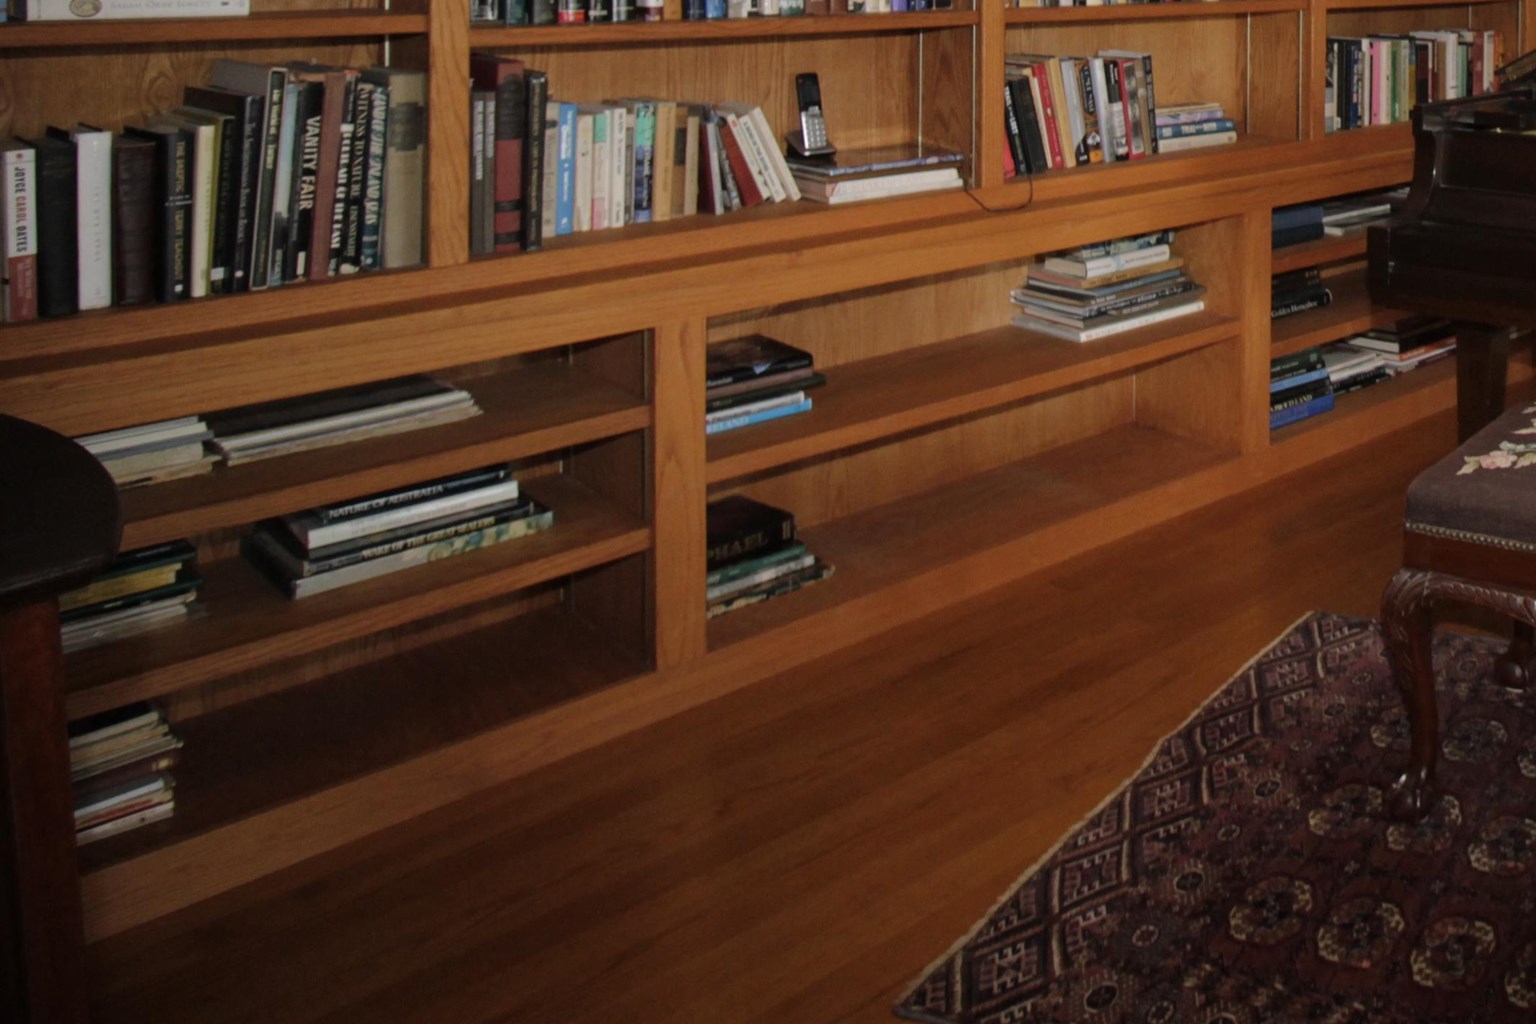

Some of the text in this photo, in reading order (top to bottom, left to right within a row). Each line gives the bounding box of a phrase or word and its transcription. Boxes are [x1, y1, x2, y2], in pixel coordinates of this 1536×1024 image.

[356, 88, 370, 137] WITNESS
[175, 141, 185, 192] THE SKEPTIC
[298, 116, 322, 212] VANITY FAIR
[354, 140, 365, 154] TO
[350, 156, 364, 198] NATURE
[14, 167, 28, 253] JOYCE CAROL OATES
[174, 238, 185, 280] TEACHOUT
[329, 484, 444, 519] NATURE OF AUSTRALIA
[406, 537, 424, 549] THE
